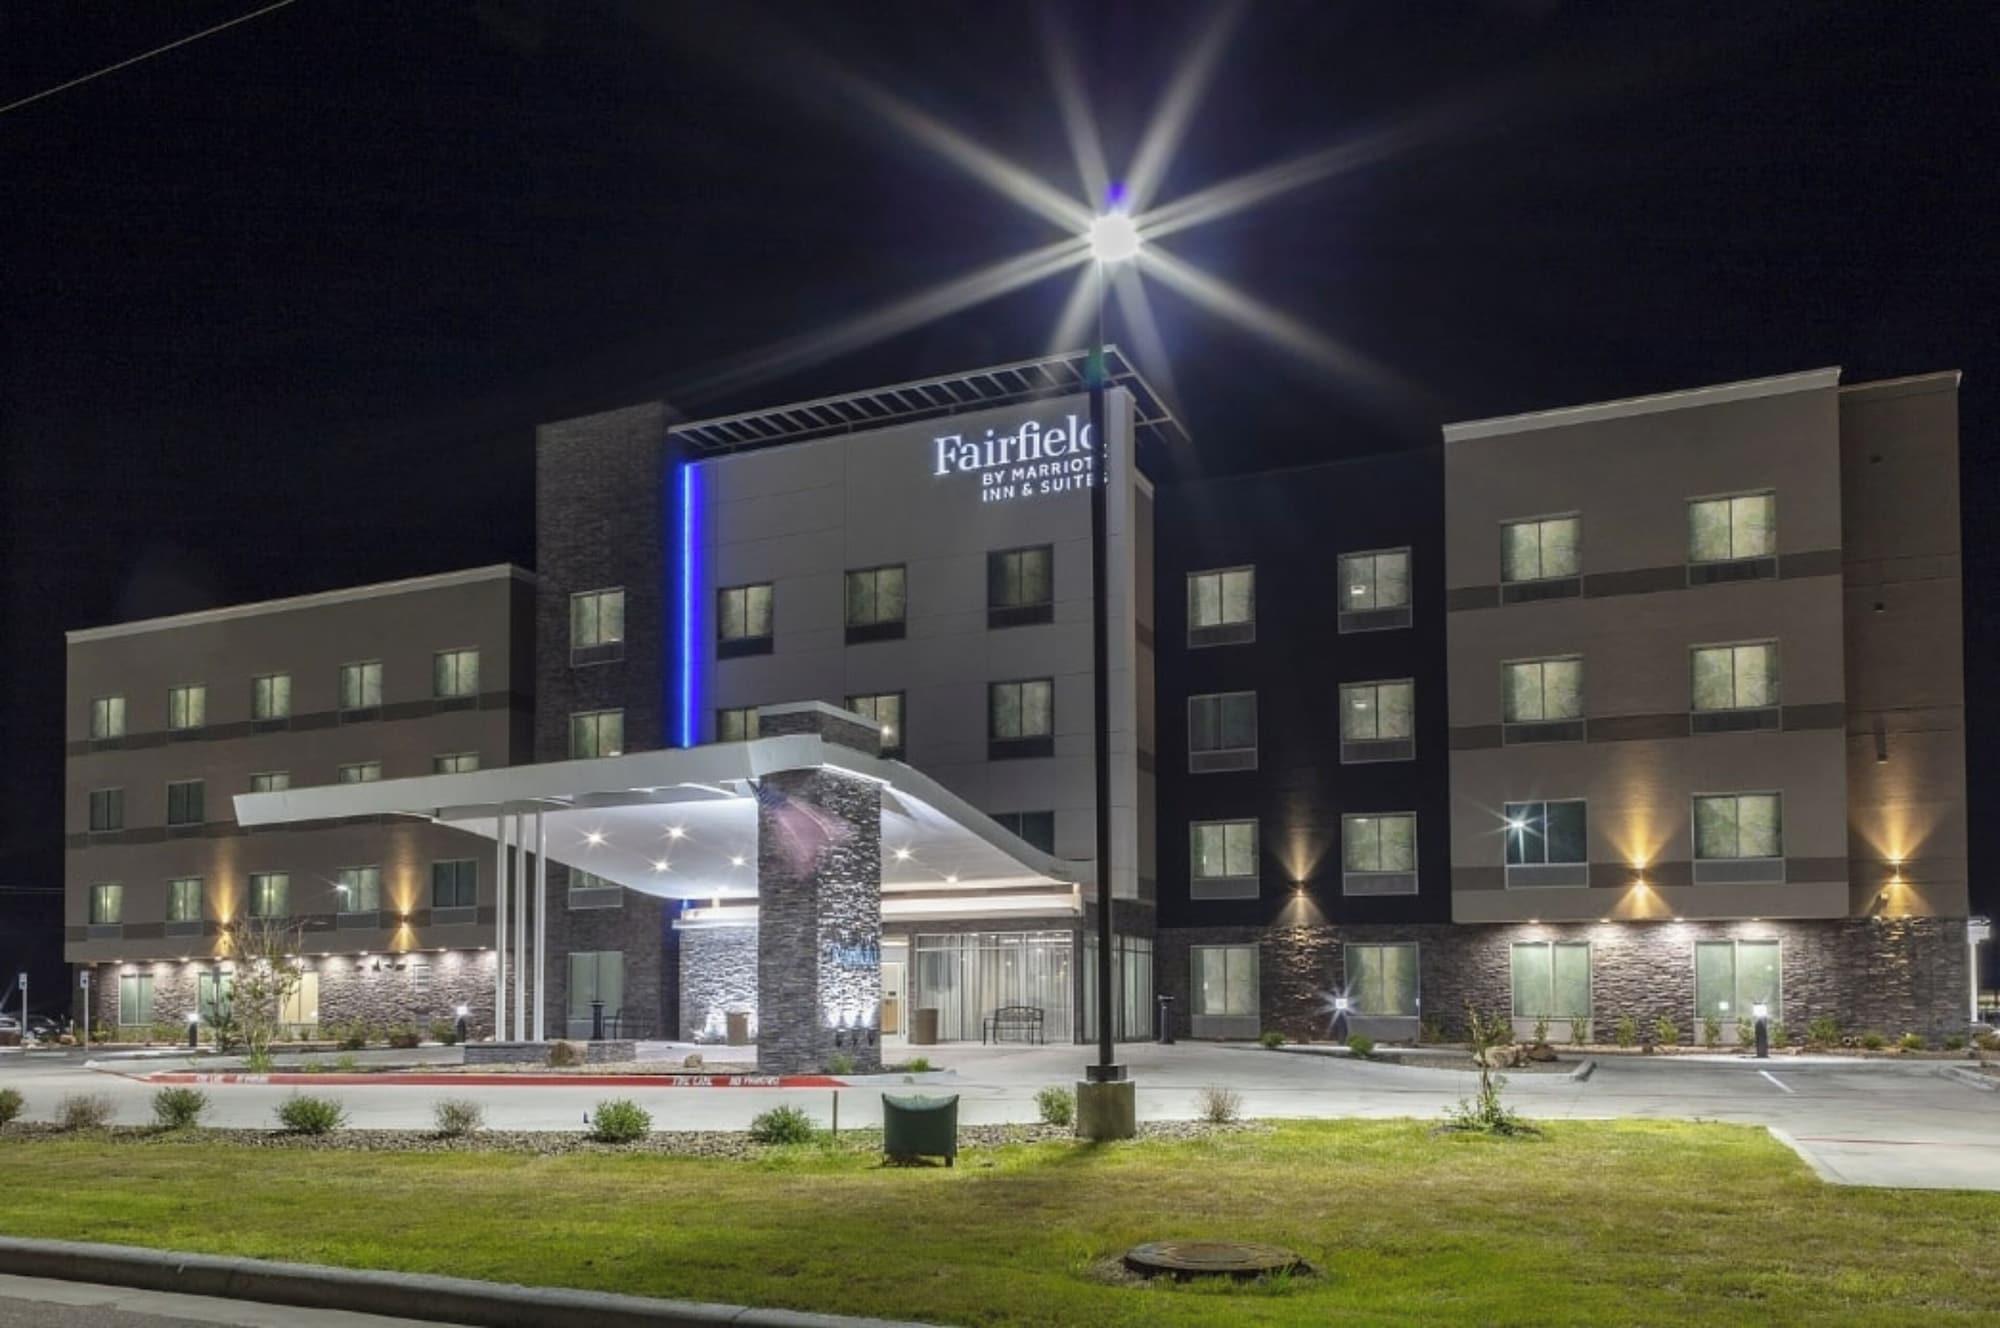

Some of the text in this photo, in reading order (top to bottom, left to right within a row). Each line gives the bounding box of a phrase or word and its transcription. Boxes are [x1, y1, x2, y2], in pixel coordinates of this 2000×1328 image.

[982, 454, 1108, 486] BY MARRIOT
[982, 485, 1014, 502] INN
[1021, 483, 1033, 497] &
